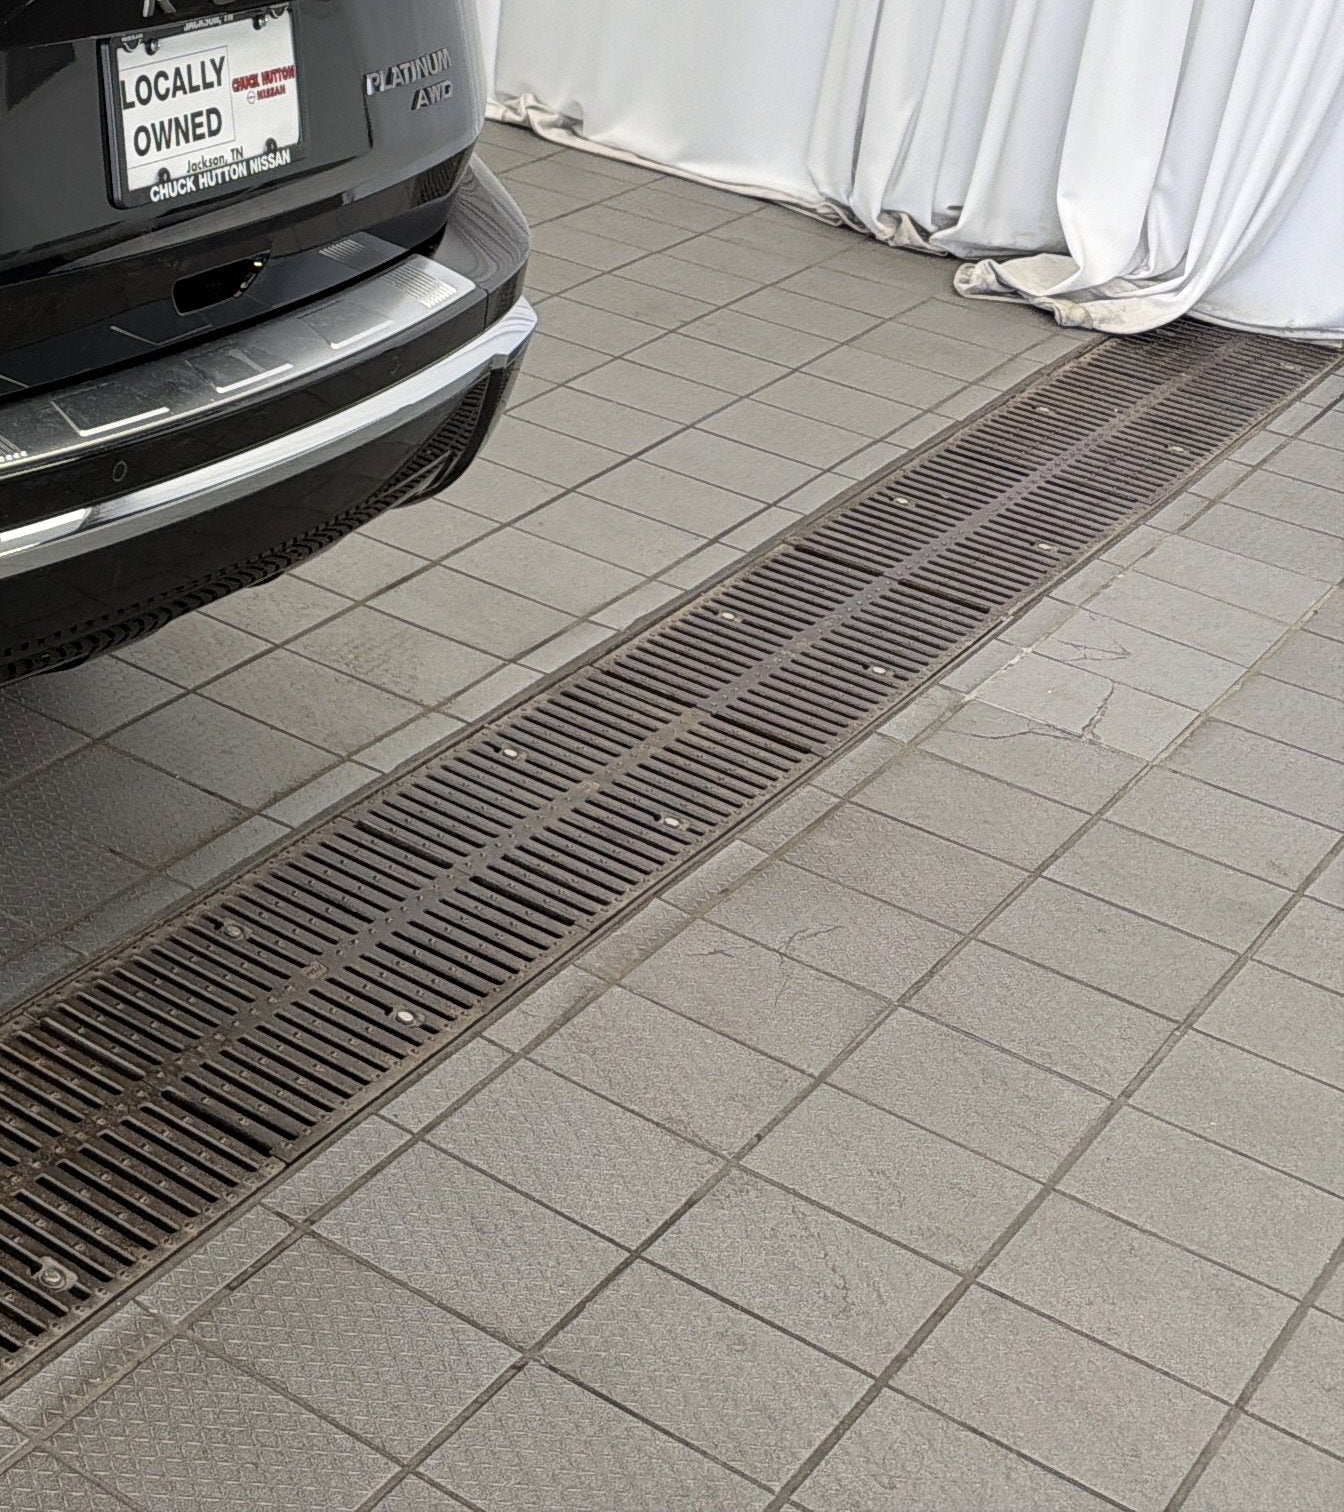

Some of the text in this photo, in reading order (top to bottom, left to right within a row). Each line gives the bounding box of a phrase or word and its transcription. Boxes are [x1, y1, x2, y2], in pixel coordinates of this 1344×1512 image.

[120, 55, 226, 110] LOCALLY
[231, 64, 296, 93] CHUCK HUTTON
[364, 47, 452, 96] PLATINUM
[411, 79, 453, 111] AWD
[133, 106, 223, 157] OWNED
[149, 148, 291, 203] CHUCK HUTTON NISSAN
[186, 146, 244, 174] Jackson, TN
